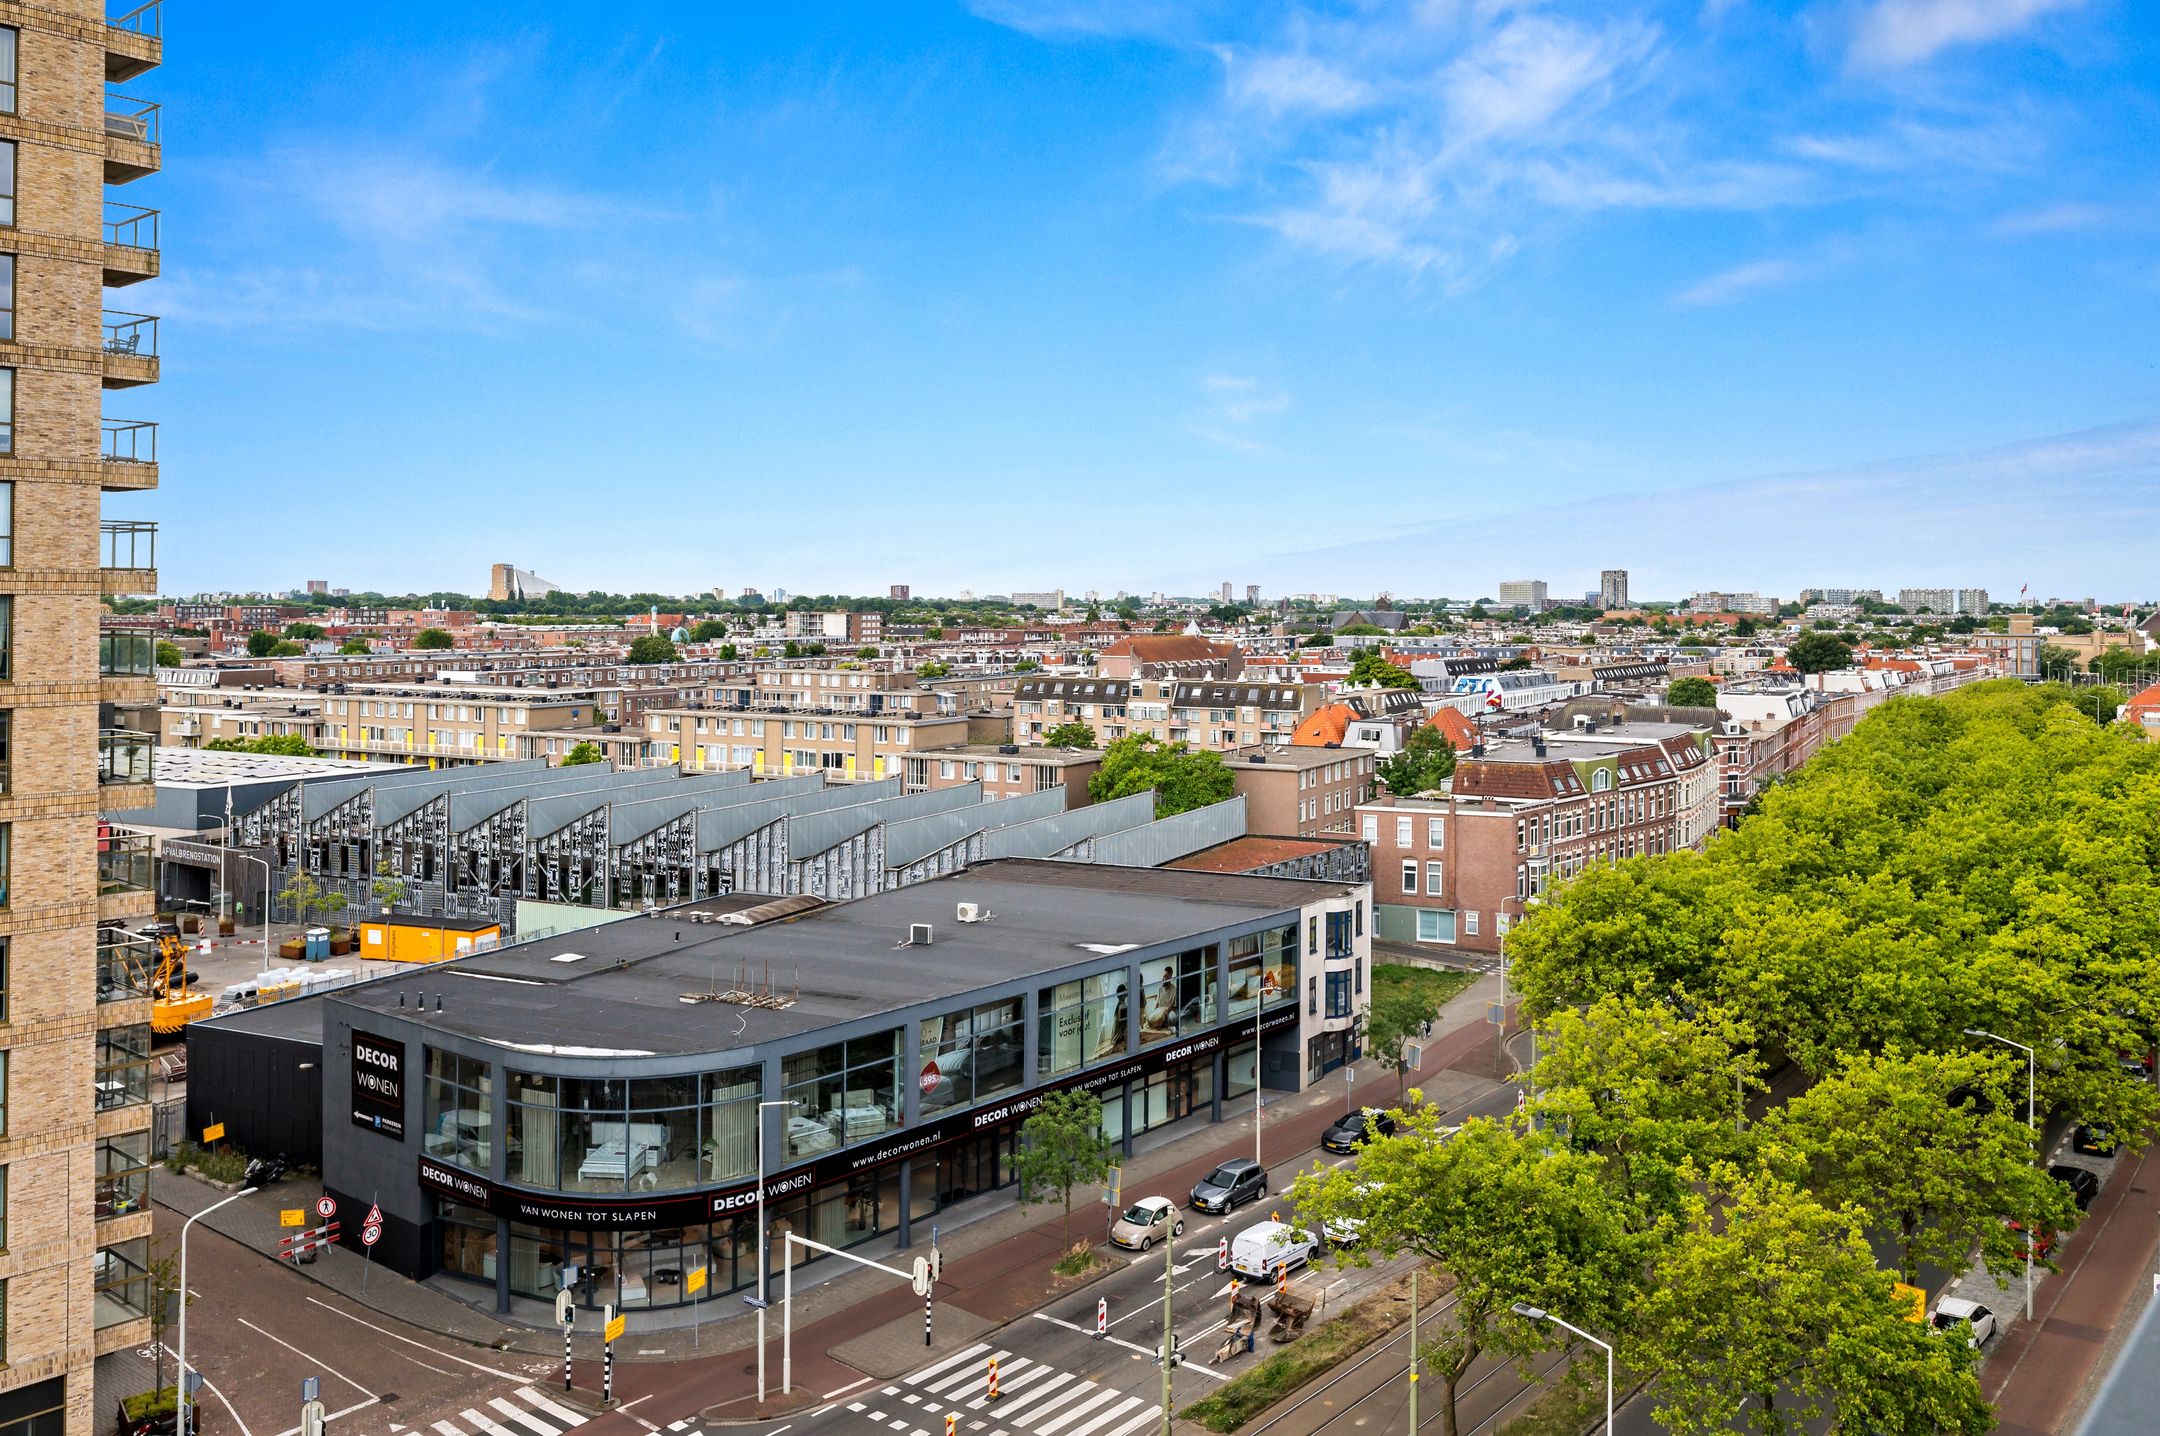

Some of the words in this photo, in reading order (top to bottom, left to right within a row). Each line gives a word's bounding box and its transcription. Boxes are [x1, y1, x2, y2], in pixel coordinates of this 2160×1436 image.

[162, 846, 220, 864] AFVALBRENGSTATION
[1242, 1012, 1295, 1036] www.ecorwonen.nl
[356, 1044, 398, 1071] DECOR
[1166, 1046, 1192, 1062] DECOR
[1193, 1036, 1219, 1051] WONEN
[356, 1070, 398, 1098] WONEN
[1084, 1076, 1107, 1090] WONEN
[1108, 1072, 1119, 1081] TOT
[1120, 1064, 1142, 1078] SLAPEN
[974, 1107, 1009, 1128] DECOR
[1010, 1095, 1043, 1115] WONEN
[852, 1130, 941, 1169] www.decorwonen.nl
[422, 1165, 453, 1187] DECOR
[454, 1177, 487, 1200] WONEN
[714, 1189, 765, 1211] DECOR
[768, 1173, 812, 1196] WONEN
[521, 1204, 539, 1216] VAN
[541, 1208, 582, 1220] WONEN
[586, 1213, 607, 1221] TOT
[612, 1211, 656, 1221] SLAPEN
[366, 1229, 377, 1239] 30
